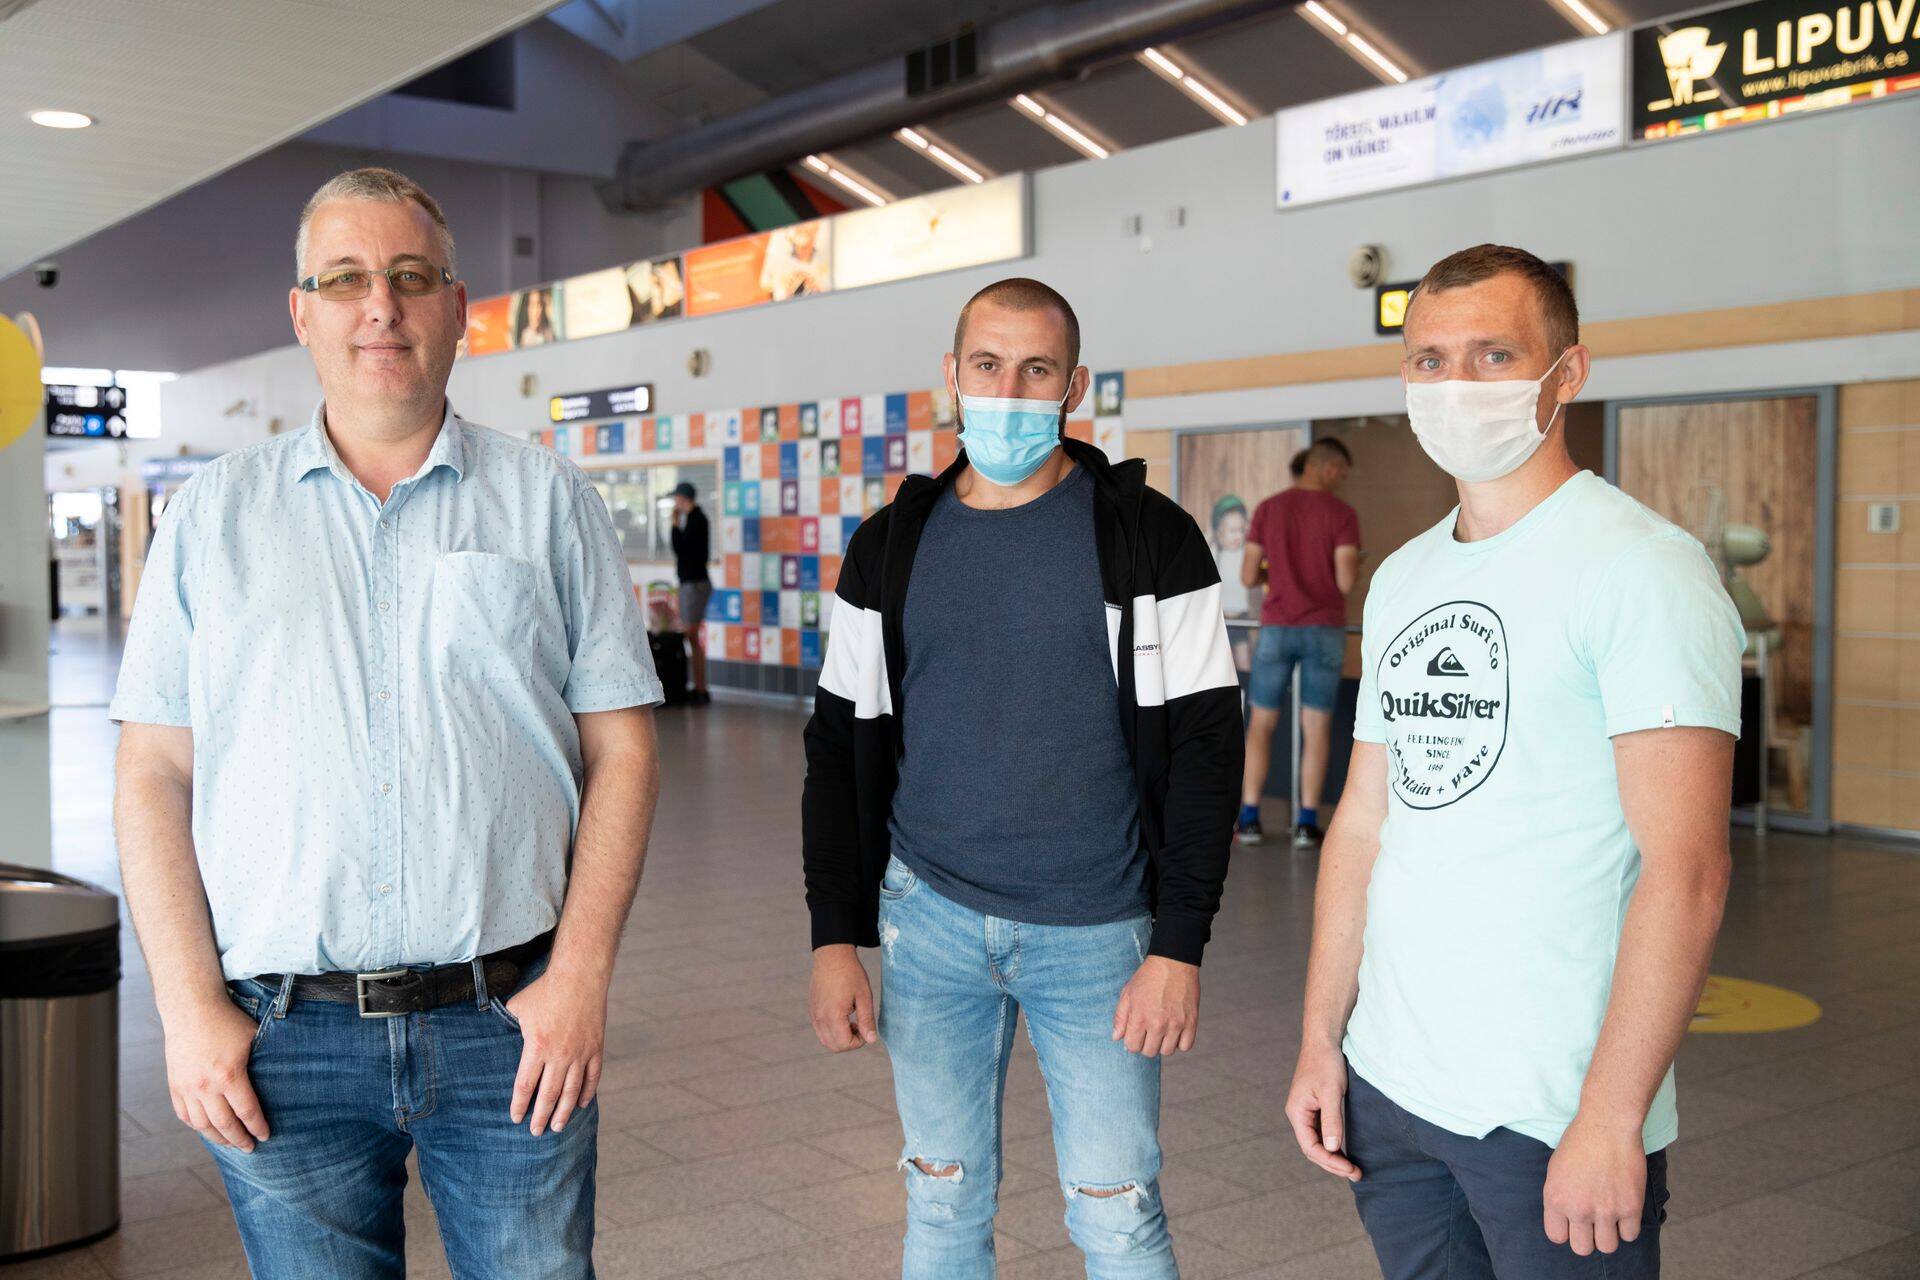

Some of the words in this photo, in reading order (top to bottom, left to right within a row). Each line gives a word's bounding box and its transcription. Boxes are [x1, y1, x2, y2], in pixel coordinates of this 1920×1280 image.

[1742, 0, 1920, 76] LIPUV
[1741, 50, 1910, 97] www.lipuvabrik.ee
[1134, 644, 1162, 652] ASSY
[1390, 614, 1456, 667] Original
[1460, 614, 1494, 643] Surf
[1489, 642, 1499, 669] Co
[1407, 734, 1449, 746] FEELING
[1450, 736, 1464, 746] FIN
[1426, 749, 1451, 759] SINCE
[1393, 739, 1431, 796] Mntain
[1451, 745, 1488, 789] wave
